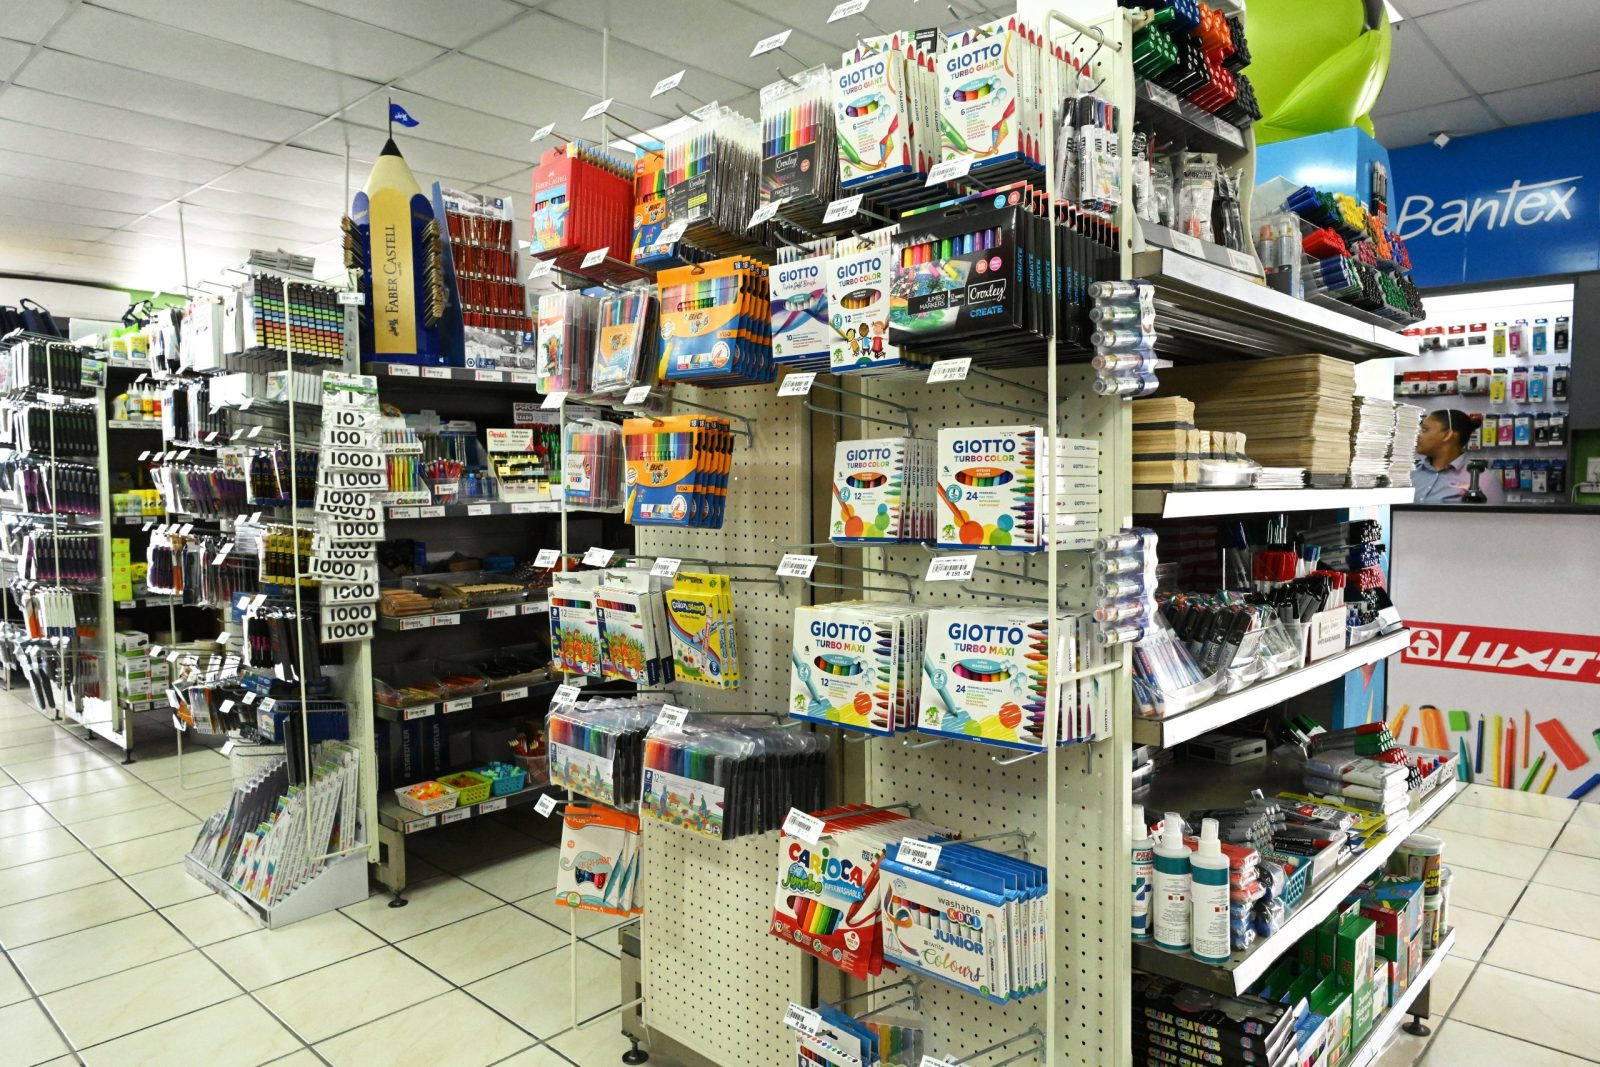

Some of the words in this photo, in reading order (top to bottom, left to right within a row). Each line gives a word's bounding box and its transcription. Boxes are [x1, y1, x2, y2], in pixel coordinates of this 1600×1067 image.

[947, 43, 1001, 72] GIOTTO
[839, 62, 884, 88] GIOTTO
[951, 67, 974, 80] TURBO
[976, 58, 999, 71] GIANT
[843, 85, 862, 96] TURBO
[864, 77, 882, 88] GIANT
[1397, 176, 1584, 240] Bantex
[382, 224, 397, 275] CASTELL
[779, 266, 818, 282] GIOTTO
[837, 258, 882, 279] GIOTTO
[839, 277, 858, 288] TURBO
[860, 272, 882, 283] COLOR
[385, 278, 398, 314] FABER
[926, 294, 945, 304] JUMBO
[970, 284, 1006, 302] Croxley
[920, 300, 945, 310] MARKERS
[970, 305, 1004, 318] CREATE
[336, 412, 354, 426] 10
[331, 430, 360, 444] 100
[846, 448, 891, 462] GIOTTO
[952, 439, 1016, 454] GIOTTO
[331, 452, 374, 466] 1000
[340, 472, 381, 486] 1000
[324, 490, 366, 506] 1000
[966, 492, 978, 500] 24
[337, 522, 378, 536] 1000
[314, 558, 356, 576] 1000
[333, 584, 374, 600] 1000
[330, 606, 372, 622] 1000
[560, 608, 566, 618] 12
[606, 610, 612, 618] 24
[328, 622, 368, 640] 1000
[810, 620, 872, 642] GIOTTO
[948, 622, 1024, 645] GIOTTO
[816, 640, 842, 650] TURBO
[844, 642, 864, 653] MAXI
[954, 643, 986, 654] TURBO
[989, 646, 1014, 656] MAXI
[1444, 631, 1600, 678] LUXO
[821, 678, 829, 686] 12
[956, 684, 966, 694] 24
[654, 773, 660, 782] 12
[788, 842, 863, 887] CARIOCA
[782, 873, 823, 894] Jumbo
[938, 897, 980, 916] washable
[948, 909, 981, 928] KOKI
[934, 928, 984, 956] JUNIOR
[921, 948, 985, 982] Colours
[1145, 1008, 1174, 1025] CHALK
[1176, 1016, 1218, 1038] CRAYONS
[1147, 1020, 1176, 1037] CHALK
[1178, 1030, 1220, 1052] CRAYONS
[1149, 1033, 1178, 1050] CHALK
[1180, 1044, 1223, 1066] CRAYONS
